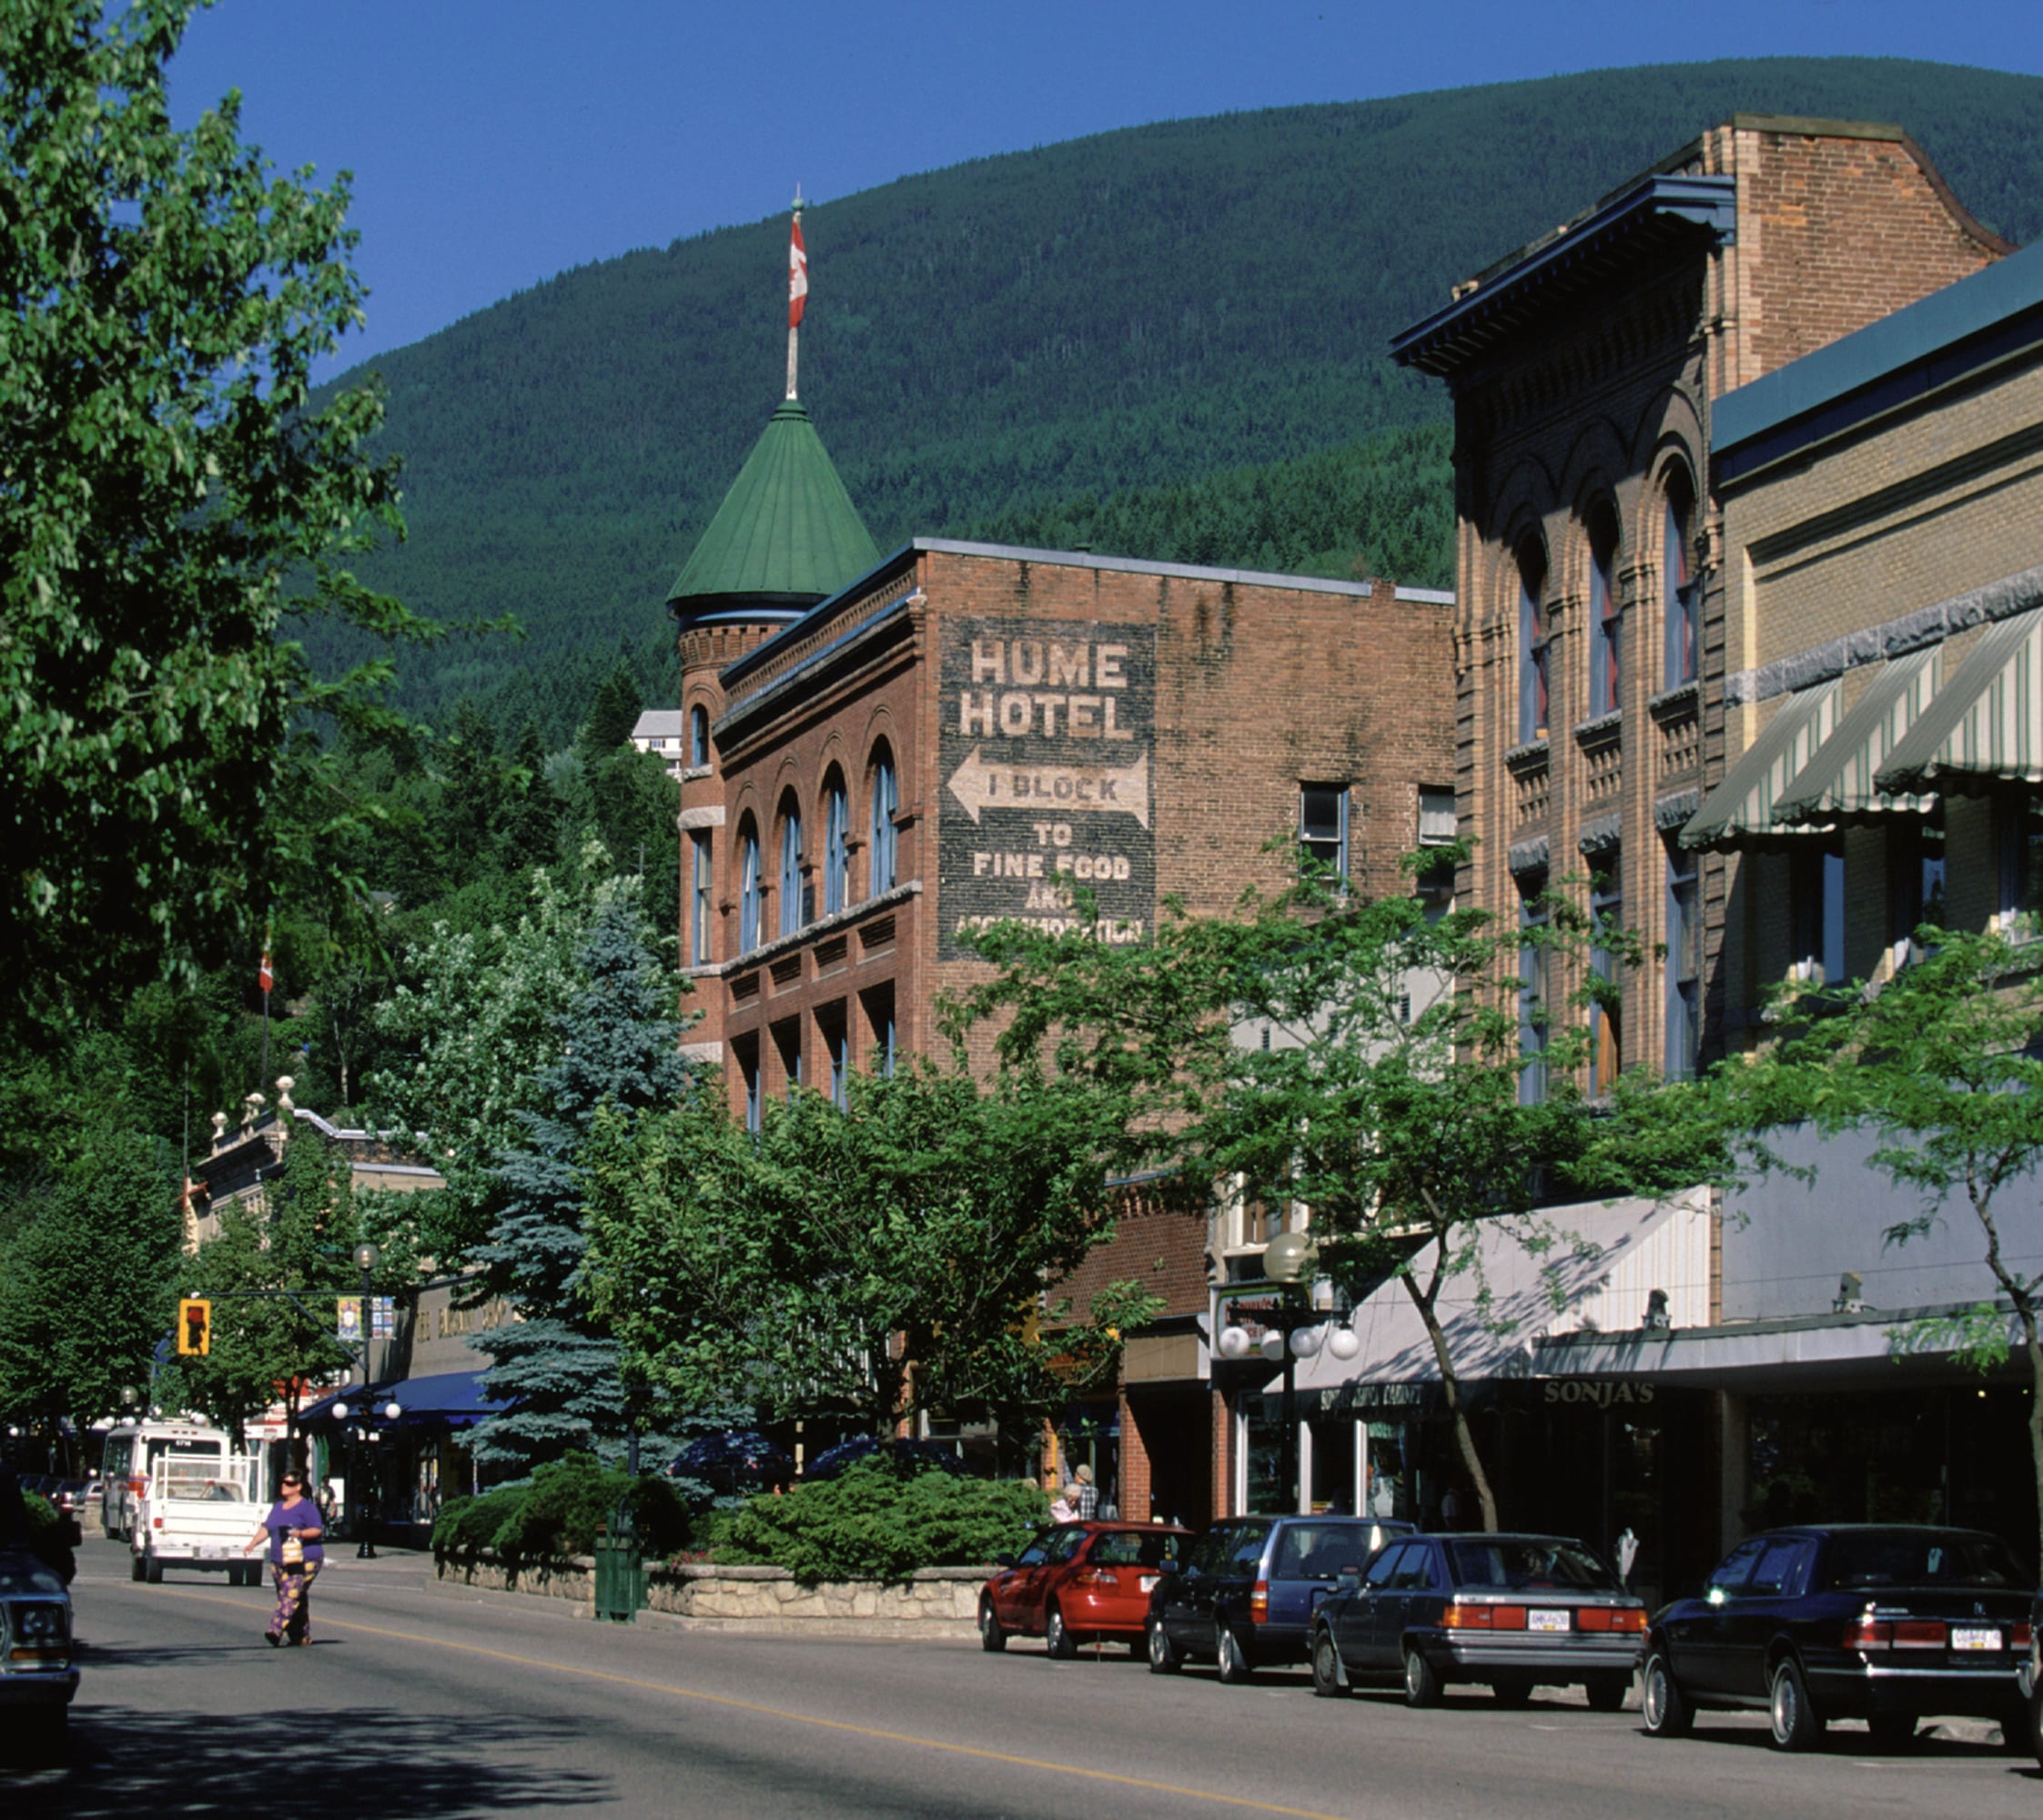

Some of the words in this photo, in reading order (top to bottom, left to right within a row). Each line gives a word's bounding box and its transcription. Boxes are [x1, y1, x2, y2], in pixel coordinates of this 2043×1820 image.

[972, 639, 1128, 688] HUME
[960, 690, 1135, 741] HOTEL
[1013, 774, 1118, 801] BLOCK
[1033, 823, 1073, 847] TO
[974, 852, 1045, 878] FINE
[1057, 854, 1131, 881] FOOD
[1543, 1380, 1654, 1409] SONJA'S
